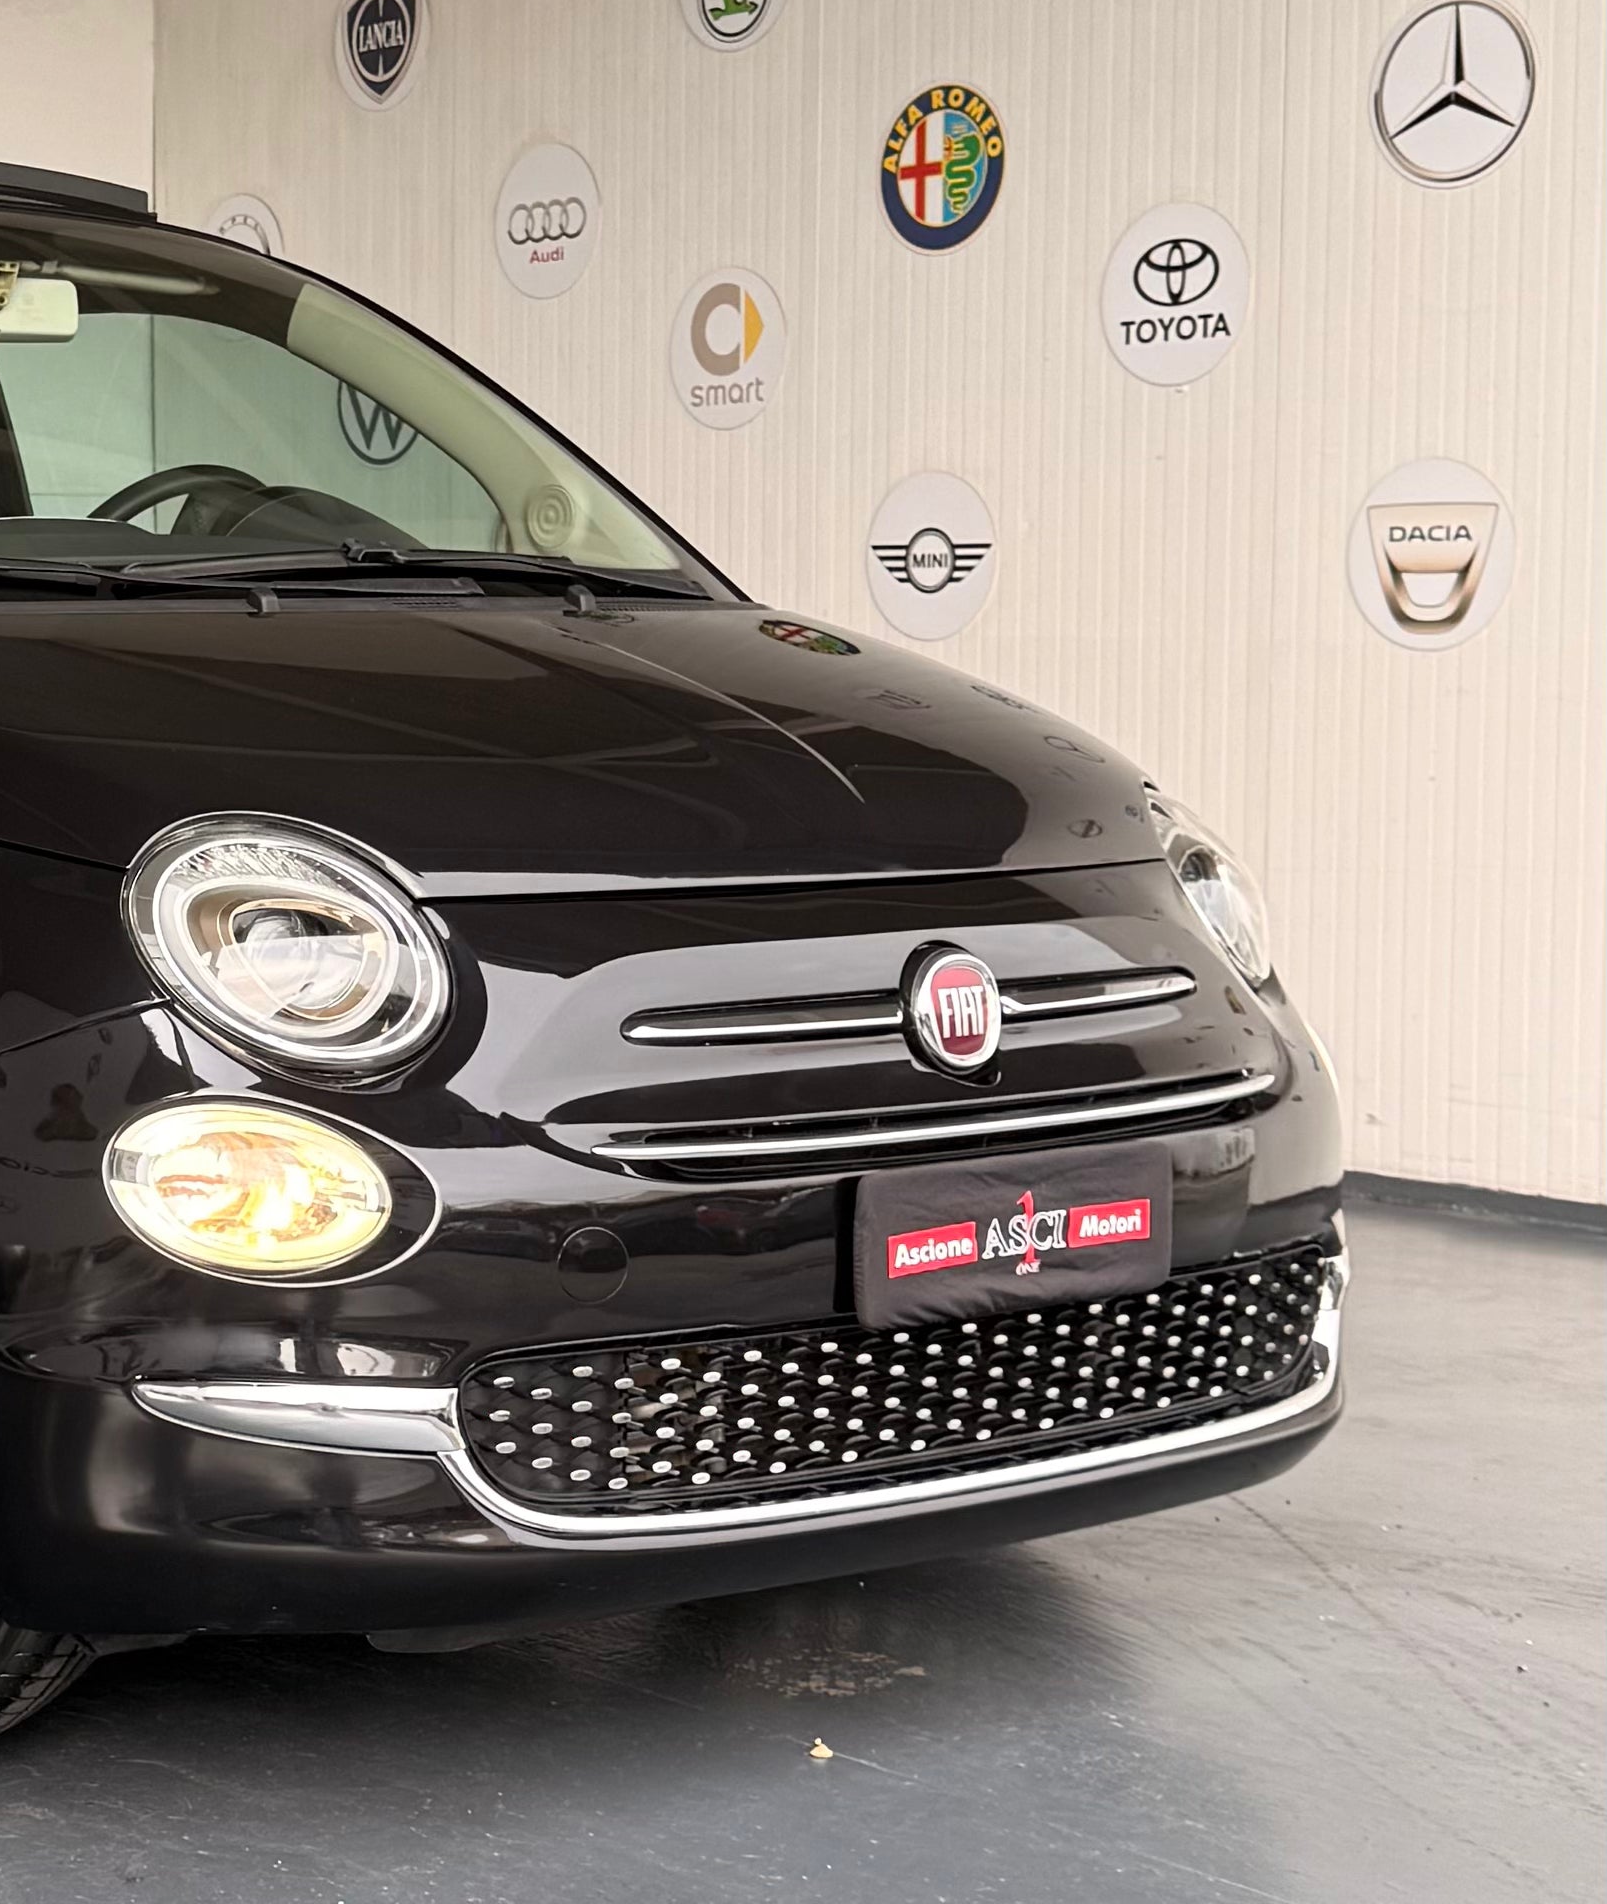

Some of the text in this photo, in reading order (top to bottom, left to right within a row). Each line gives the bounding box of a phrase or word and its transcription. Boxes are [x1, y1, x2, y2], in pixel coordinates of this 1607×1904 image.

[358, 19, 404, 53] LANCIA
[883, 88, 1003, 174] ALFA ROMEO
[529, 246, 564, 264] Audi
[1120, 312, 1232, 347] TOYOTA
[690, 378, 765, 408] smart
[1387, 523, 1473, 544] DACIA
[911, 552, 950, 569] MINI
[937, 985, 984, 1039] FIAT
[893, 1208, 1142, 1269] Ascione ASCI Motori
